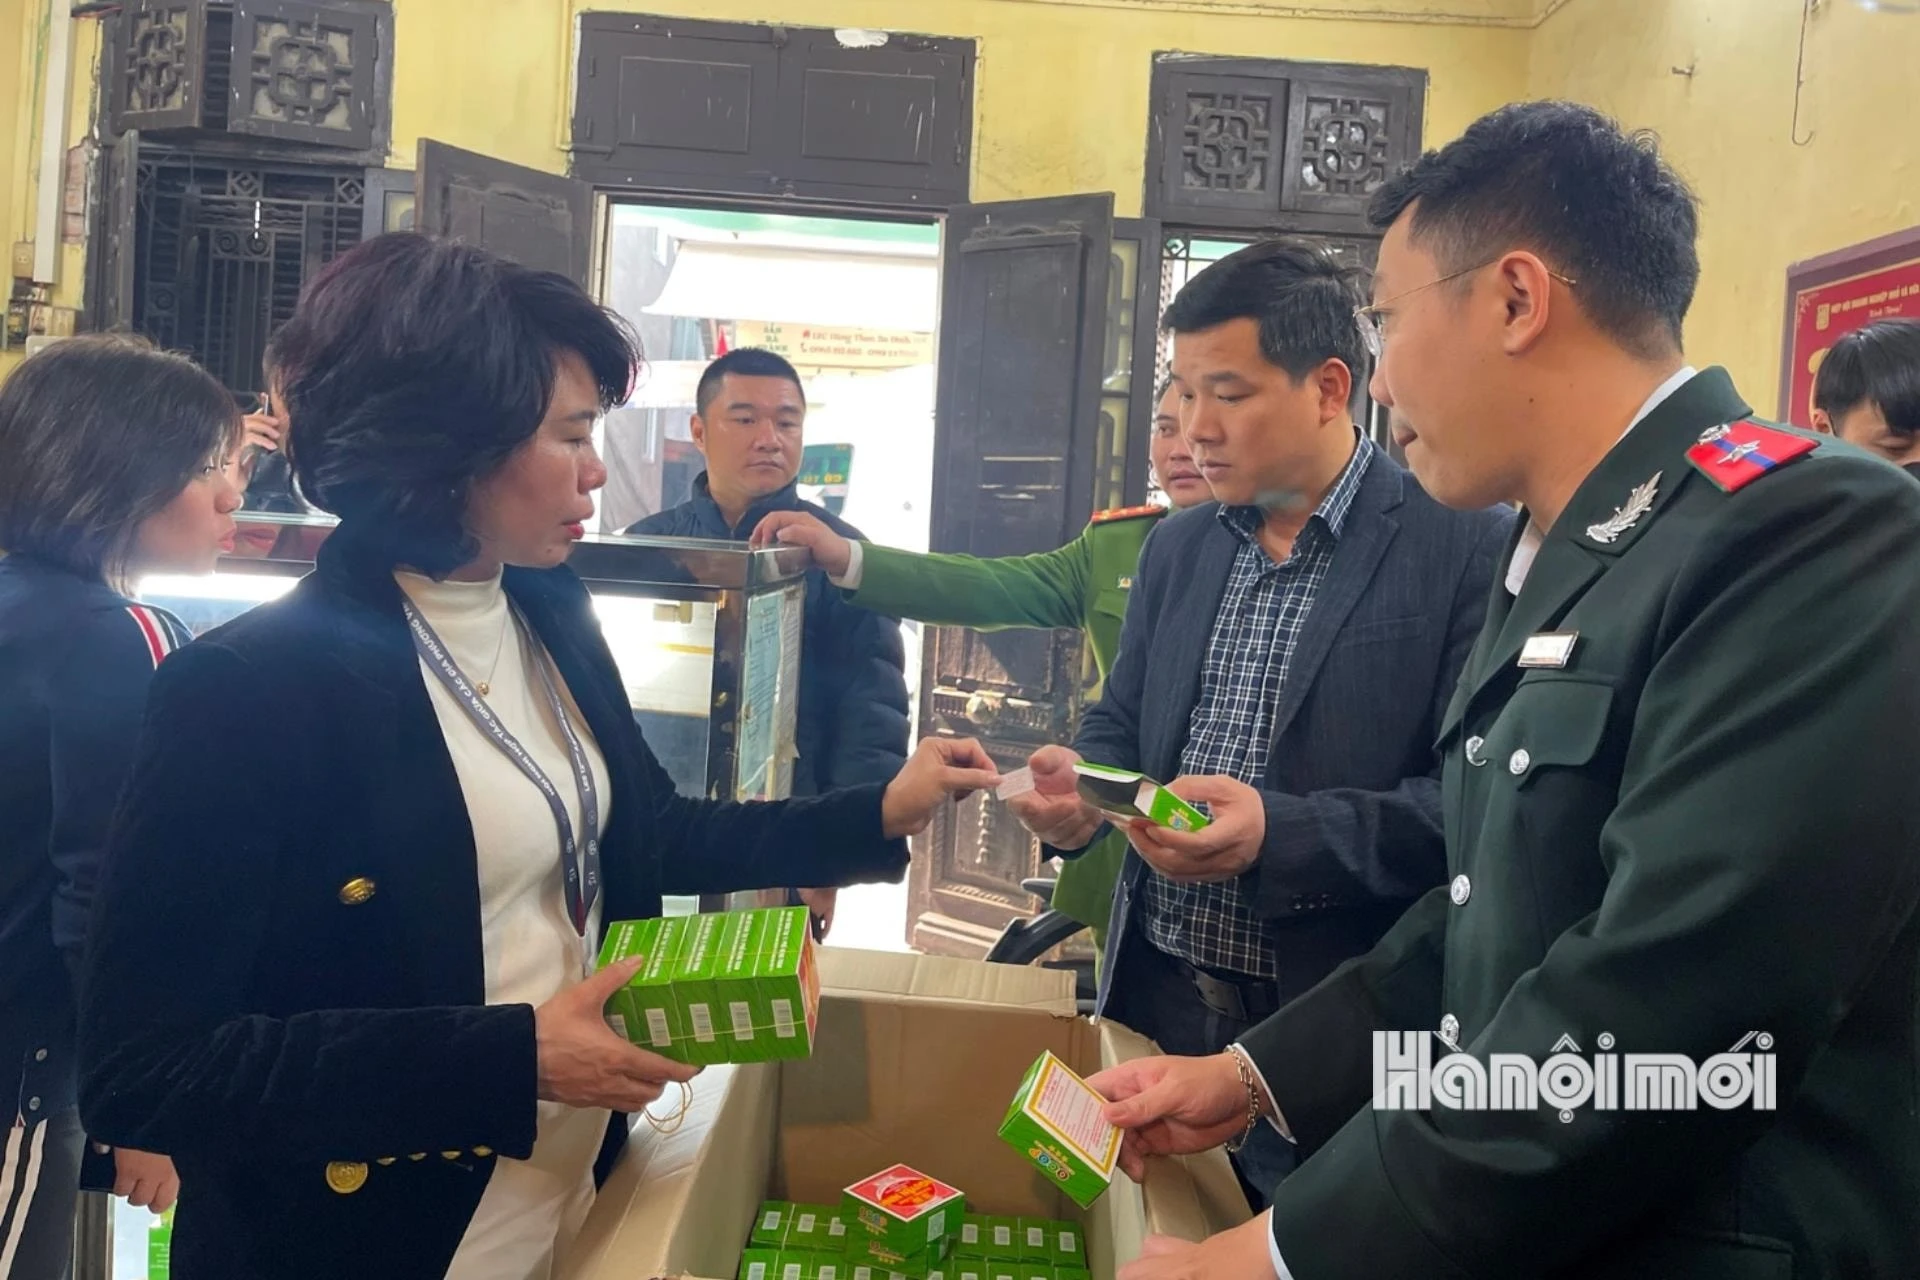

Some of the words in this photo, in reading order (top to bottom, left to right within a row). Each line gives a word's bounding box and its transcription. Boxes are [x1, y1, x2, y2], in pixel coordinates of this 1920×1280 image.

[411, 619, 444, 660] PHƯƠNG
[455, 677, 472, 697] CÁC
[489, 719, 504, 738] TÁC
